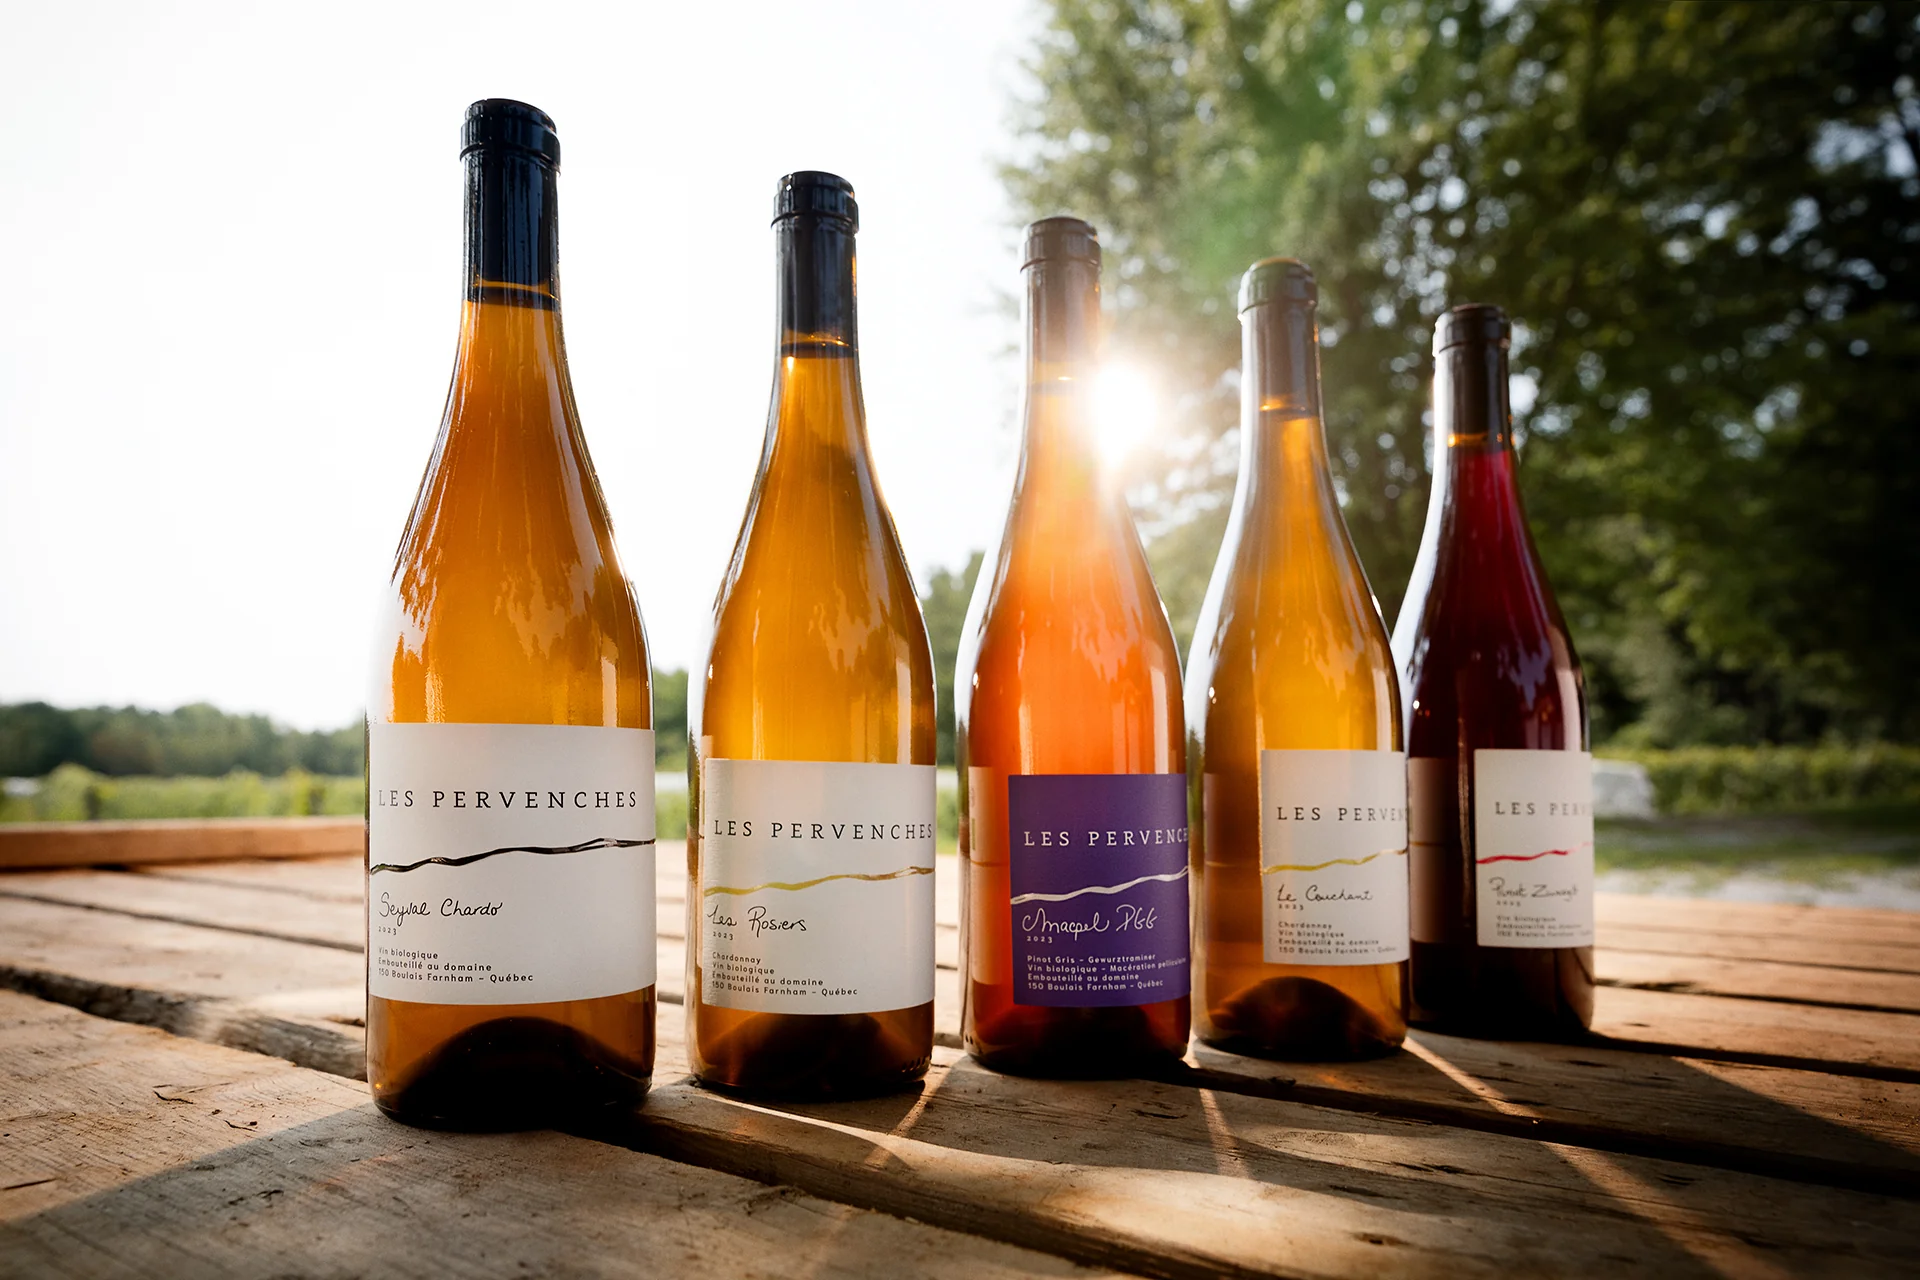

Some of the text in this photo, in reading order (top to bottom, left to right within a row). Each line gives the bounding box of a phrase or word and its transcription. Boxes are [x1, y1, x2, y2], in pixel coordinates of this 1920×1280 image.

[379, 790, 637, 809] LES PERVENCHES
[1277, 807, 1321, 821] LES
[1495, 801, 1536, 815] LES
[714, 820, 932, 840] LES PERVENCHES
[1024, 831, 1070, 847] LES
[1277, 884, 1373, 902] Le Couchant
[379, 892, 503, 926] Seyval Chardo
[707, 905, 807, 938] Les Rosiers
[378, 926, 397, 935] 2023
[713, 931, 734, 941] 2023
[1027, 936, 1053, 944] 2023
[391, 949, 438, 960] biologique
[712, 952, 761, 965] Chardonnay
[1027, 955, 1051, 963] Pinot
[1055, 955, 1075, 964] Gris
[1088, 954, 1156, 964] Gewurztraminer
[378, 957, 423, 970] Embouteillé
[444, 963, 492, 971] domaine
[712, 962, 775, 975] Vin biologique
[1028, 964, 1043, 972] Vin
[1046, 965, 1097, 974] biologique
[1110, 962, 1156, 972] Macération
[379, 968, 389, 976] 150
[392, 970, 423, 981] Boulais
[427, 973, 473, 982] Farnham
[490, 973, 533, 983] Québec
[712, 971, 759, 984] Embouteillé
[780, 978, 823, 986] domaine
[1028, 973, 1083, 982] Embouteillé
[1102, 973, 1139, 981] domaine
[712, 981, 724, 989] 150
[728, 984, 759, 993] Boulais
[764, 987, 807, 996] Farnham
[821, 988, 858, 997] Québec
[1048, 983, 1083, 991] Boulais
[1087, 983, 1126, 991] Farnham
[1137, 979, 1163, 989] Québec
